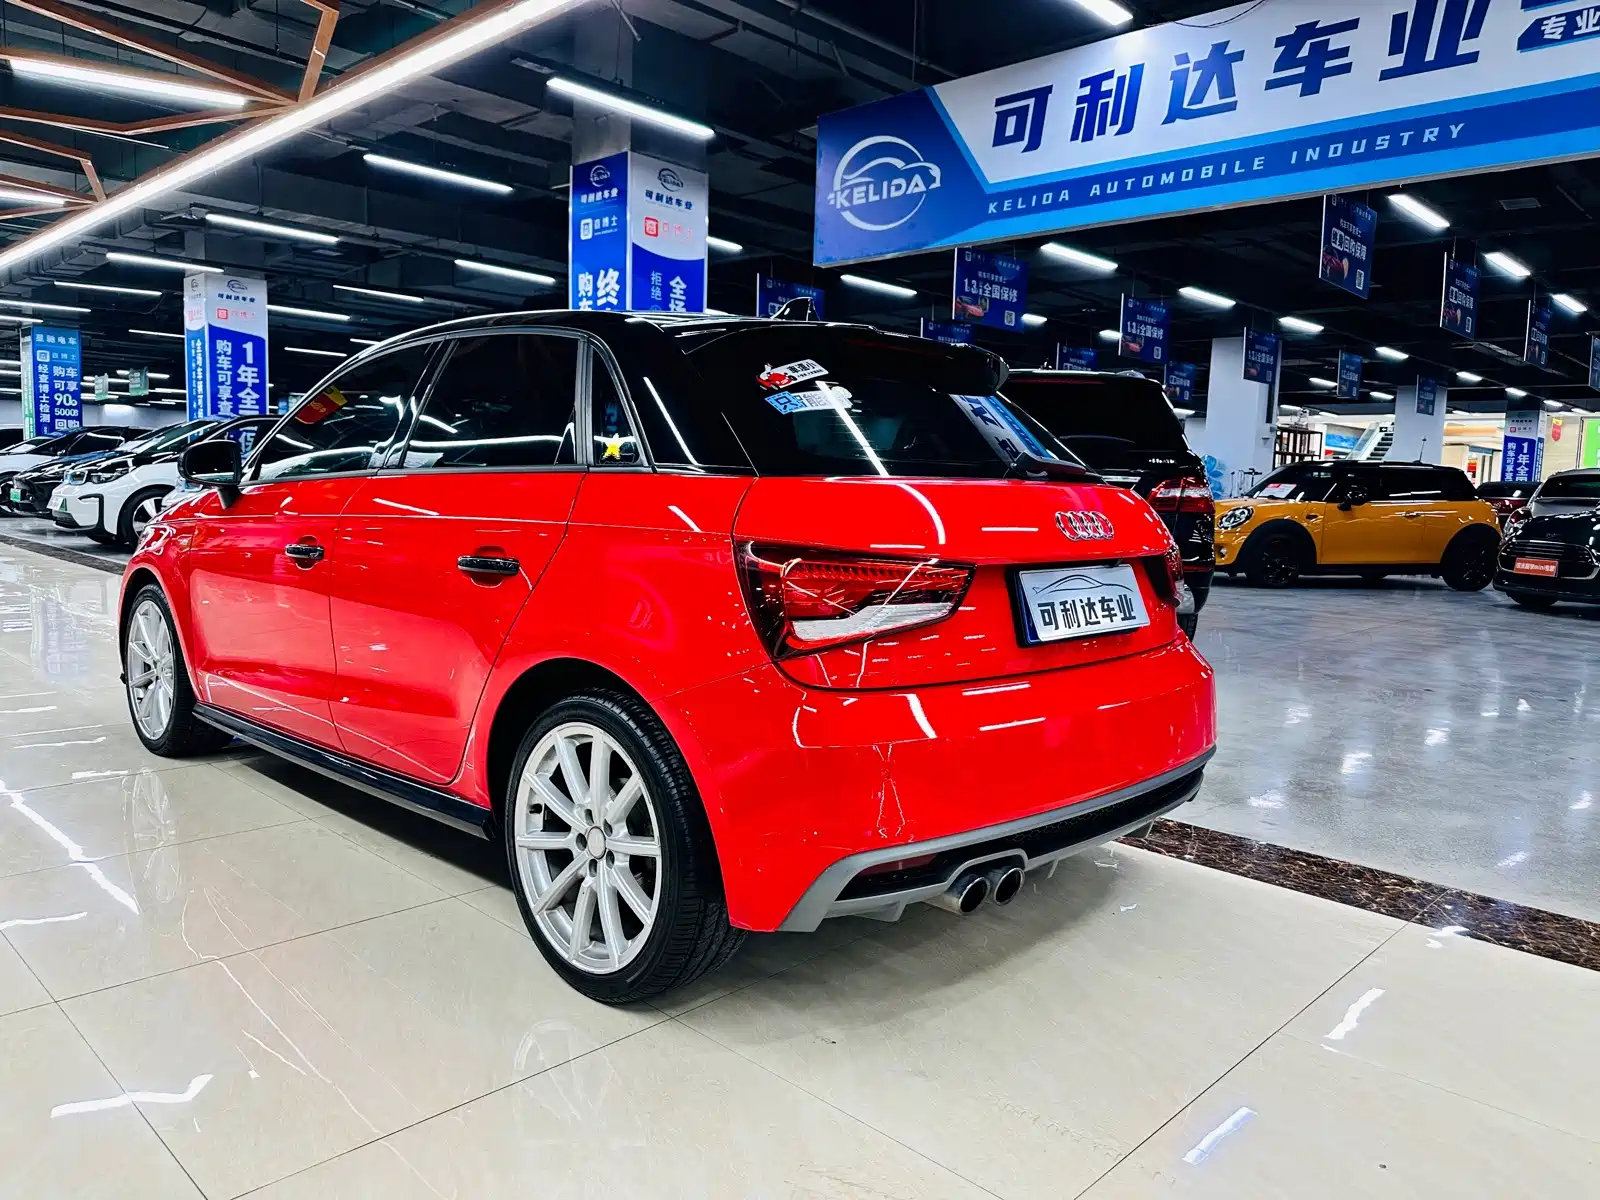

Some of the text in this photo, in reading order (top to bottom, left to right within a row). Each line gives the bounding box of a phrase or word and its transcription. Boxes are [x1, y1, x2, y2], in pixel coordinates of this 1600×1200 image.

[992, 0, 1491, 153] 可利达车业
[988, 122, 1465, 214] KELIDA AUTOMOBILE INDUSTRY
[836, 174, 926, 209] KELIDA
[53, 380, 79, 392] 可享
[1037, 594, 1136, 630] 可利达车业
